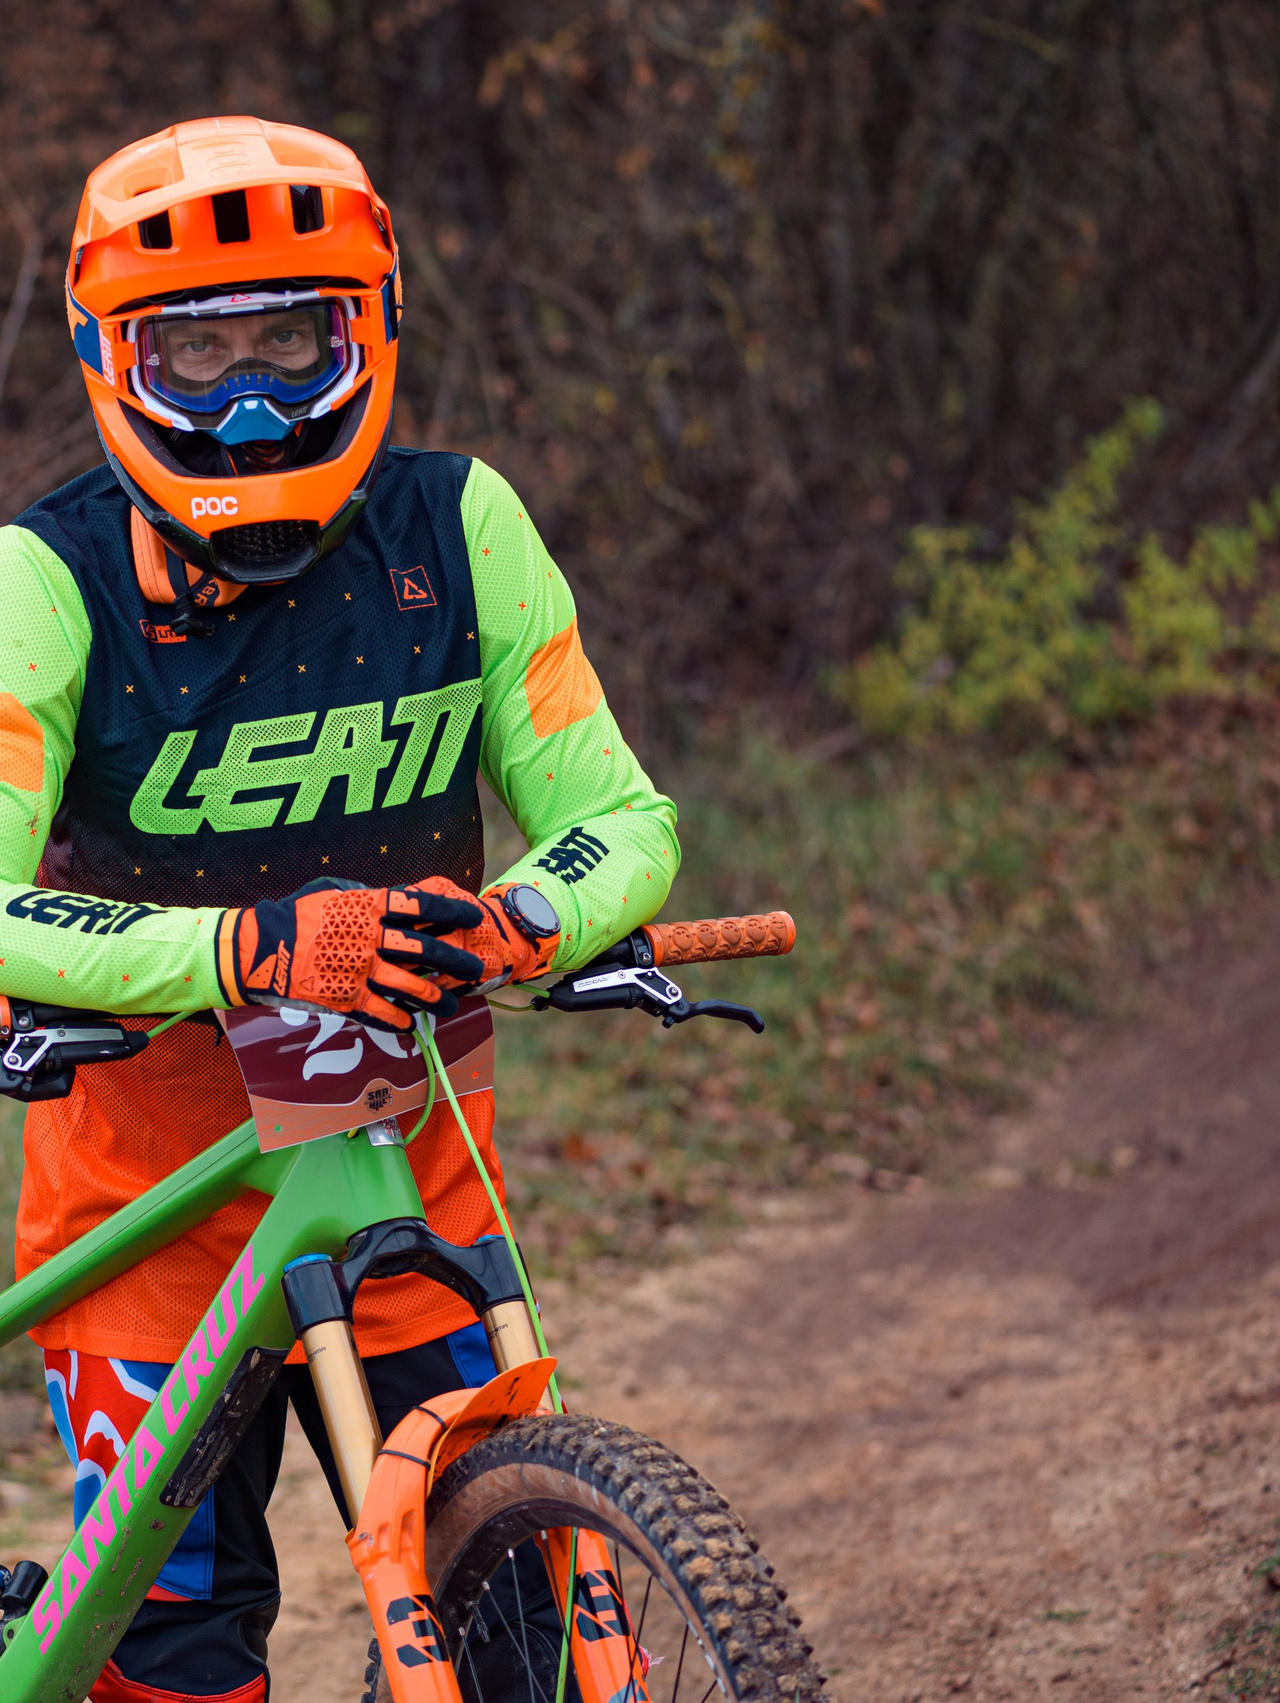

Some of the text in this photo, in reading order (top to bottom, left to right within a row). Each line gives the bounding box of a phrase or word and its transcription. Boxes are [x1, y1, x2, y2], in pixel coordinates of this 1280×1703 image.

[98, 327, 116, 386] LEATT
[129, 677, 482, 835] LEATT
[6, 890, 168, 935] LEATT
[273, 940, 291, 996] LEATT
[33, 1244, 264, 1654] SANTA CRUZ
